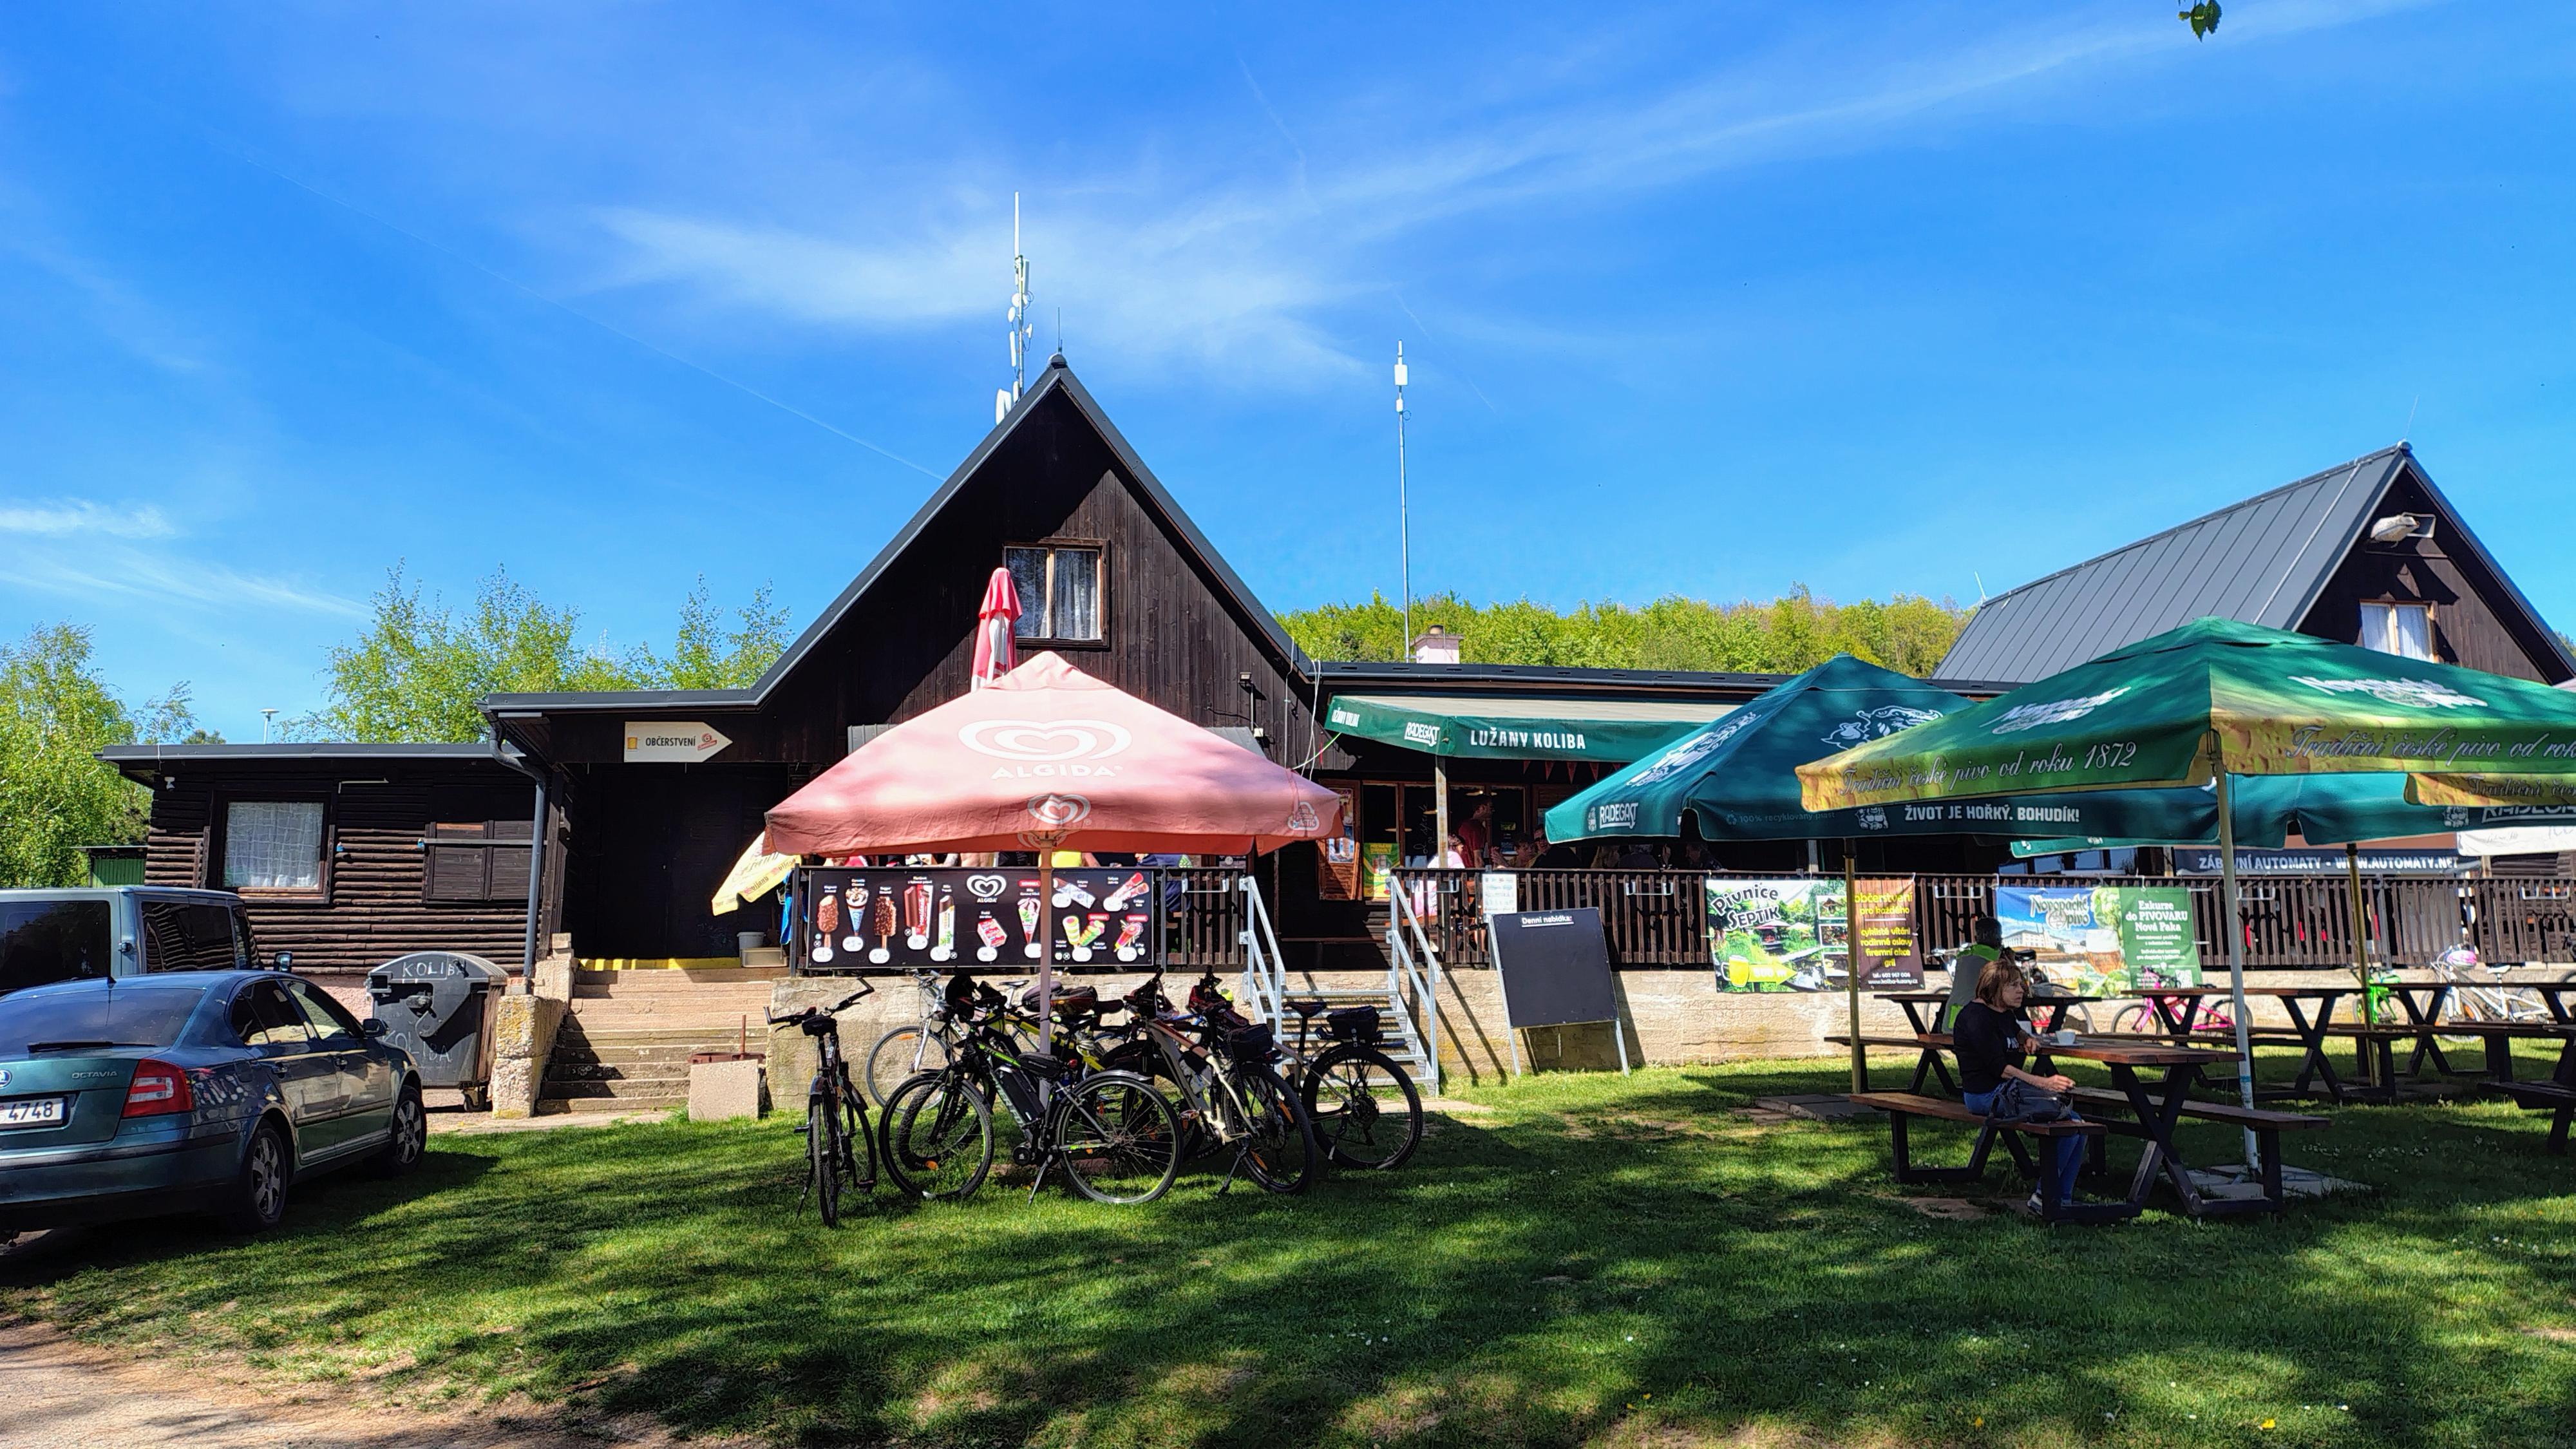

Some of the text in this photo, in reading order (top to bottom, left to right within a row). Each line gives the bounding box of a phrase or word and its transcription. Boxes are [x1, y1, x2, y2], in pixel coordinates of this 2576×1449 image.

[645, 735, 696, 746] OBČERSTVENÍ
[1405, 722, 1440, 746] RADEGAST
[1470, 726, 1586, 750] LUŽANY KOLIBA
[2286, 724, 2392, 758] Tradiční
[2391, 726, 2458, 758] české
[2445, 735, 2501, 766] pivo
[2510, 732, 2550, 758] od
[990, 763, 1117, 781] ALGIDA
[1840, 741, 2137, 795] Tradiční české pivo od roku 1872
[1599, 802, 1639, 829] RADEGAST
[1739, 815, 1763, 823] 100%
[1904, 804, 2080, 822] ŽIVOT JE HOŘKÝ. BOHUDÍK!
[2199, 854, 2252, 869] ZÁBNÍ
[2255, 857, 2321, 869] AUTOMATY
[1711, 882, 1779, 916] Pivnice
[1855, 892, 1913, 903] občerstvení
[2029, 894, 2088, 918] Novopacké
[2138, 900, 2174, 910] Exkurze
[1521, 916, 1542, 925] Denní
[1728, 906, 1781, 929] SEPTIK
[2066, 913, 2090, 929] pivo
[2125, 910, 2188, 921] do PIVOVARU
[2135, 922, 2182, 932] Nová Paka
[71, 1070, 118, 1079] OCTAVIA
[8, 1101, 53, 1121] 4748
